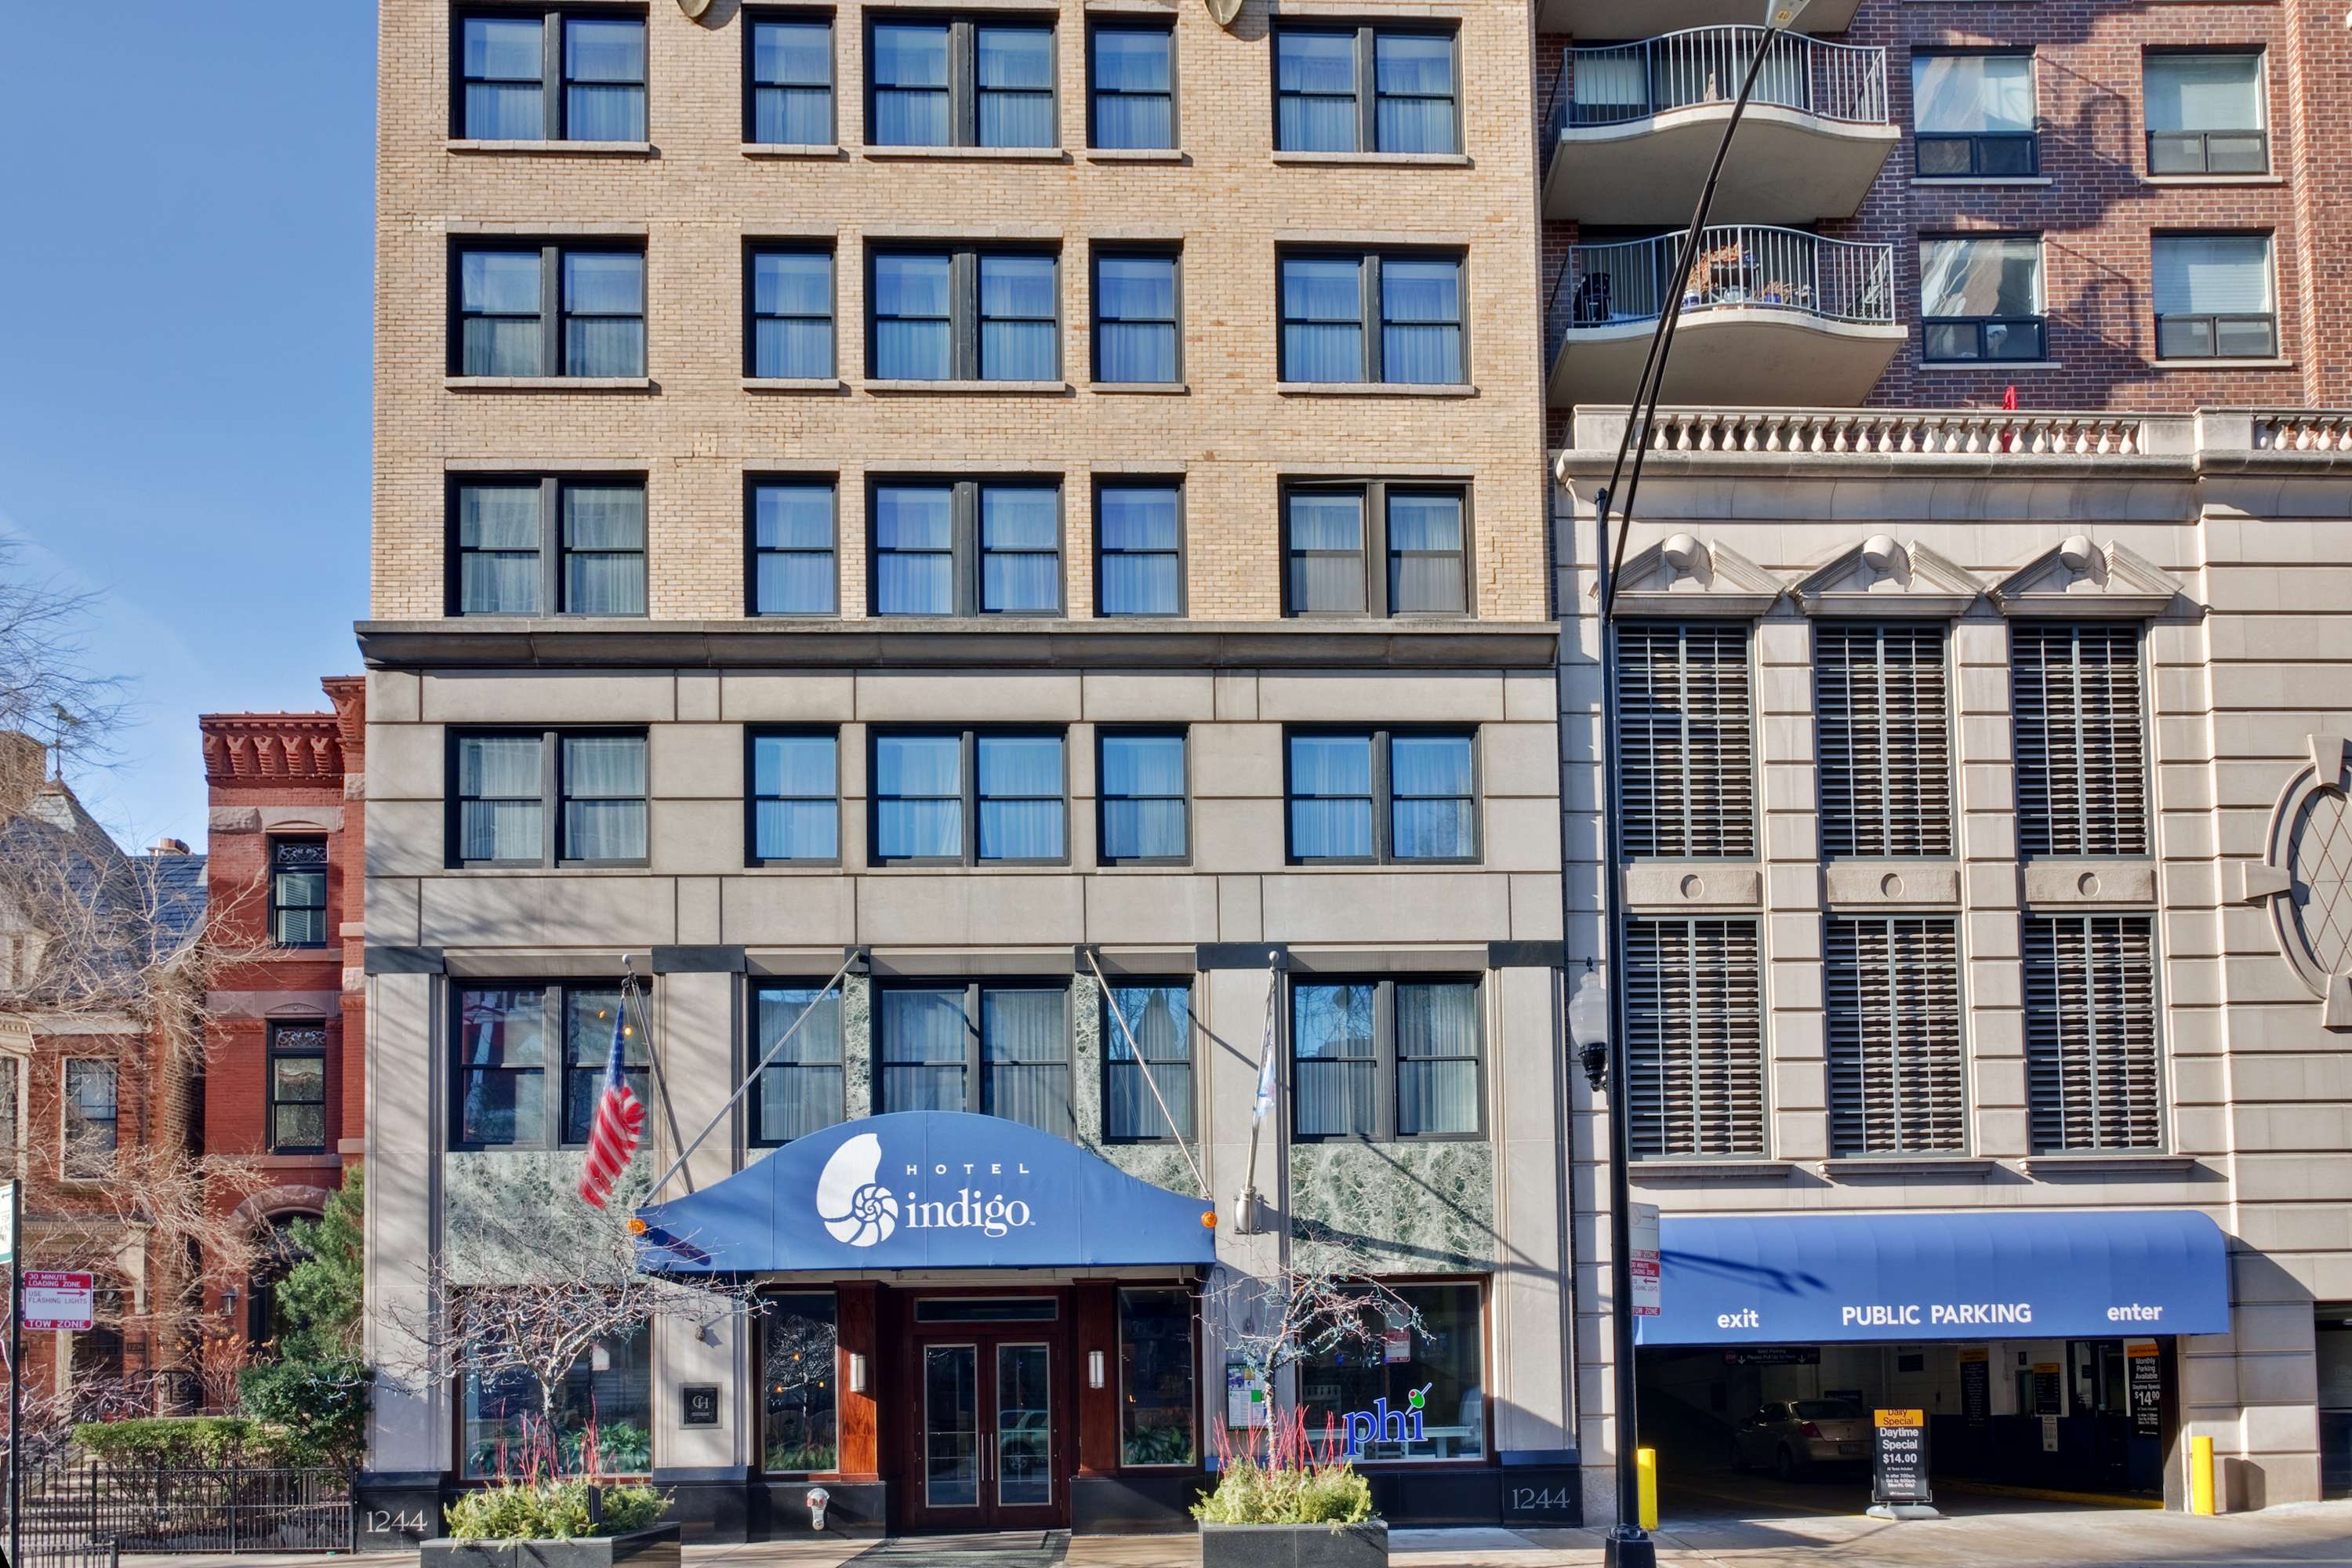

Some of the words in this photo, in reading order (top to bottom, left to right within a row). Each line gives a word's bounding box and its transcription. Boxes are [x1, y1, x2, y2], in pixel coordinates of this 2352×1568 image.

[906, 1163, 1029, 1175] HOTEL
[906, 1188, 1030, 1237] indigo
[1717, 1308, 1759, 1328] exit
[1842, 1305, 1921, 1326] PUBLIC
[1930, 1303, 2032, 1324] PARKING
[2107, 1303, 2162, 1321] enter
[1342, 1389, 1428, 1455] phi
[1883, 1417, 1914, 1425] Special
[1879, 1427, 1919, 1439] Daytime
[1882, 1439, 1918, 1451] Special
[1882, 1453, 1918, 1465] $14.00
[1512, 1487, 1570, 1509] 1244
[366, 1510, 428, 1532] 1244
